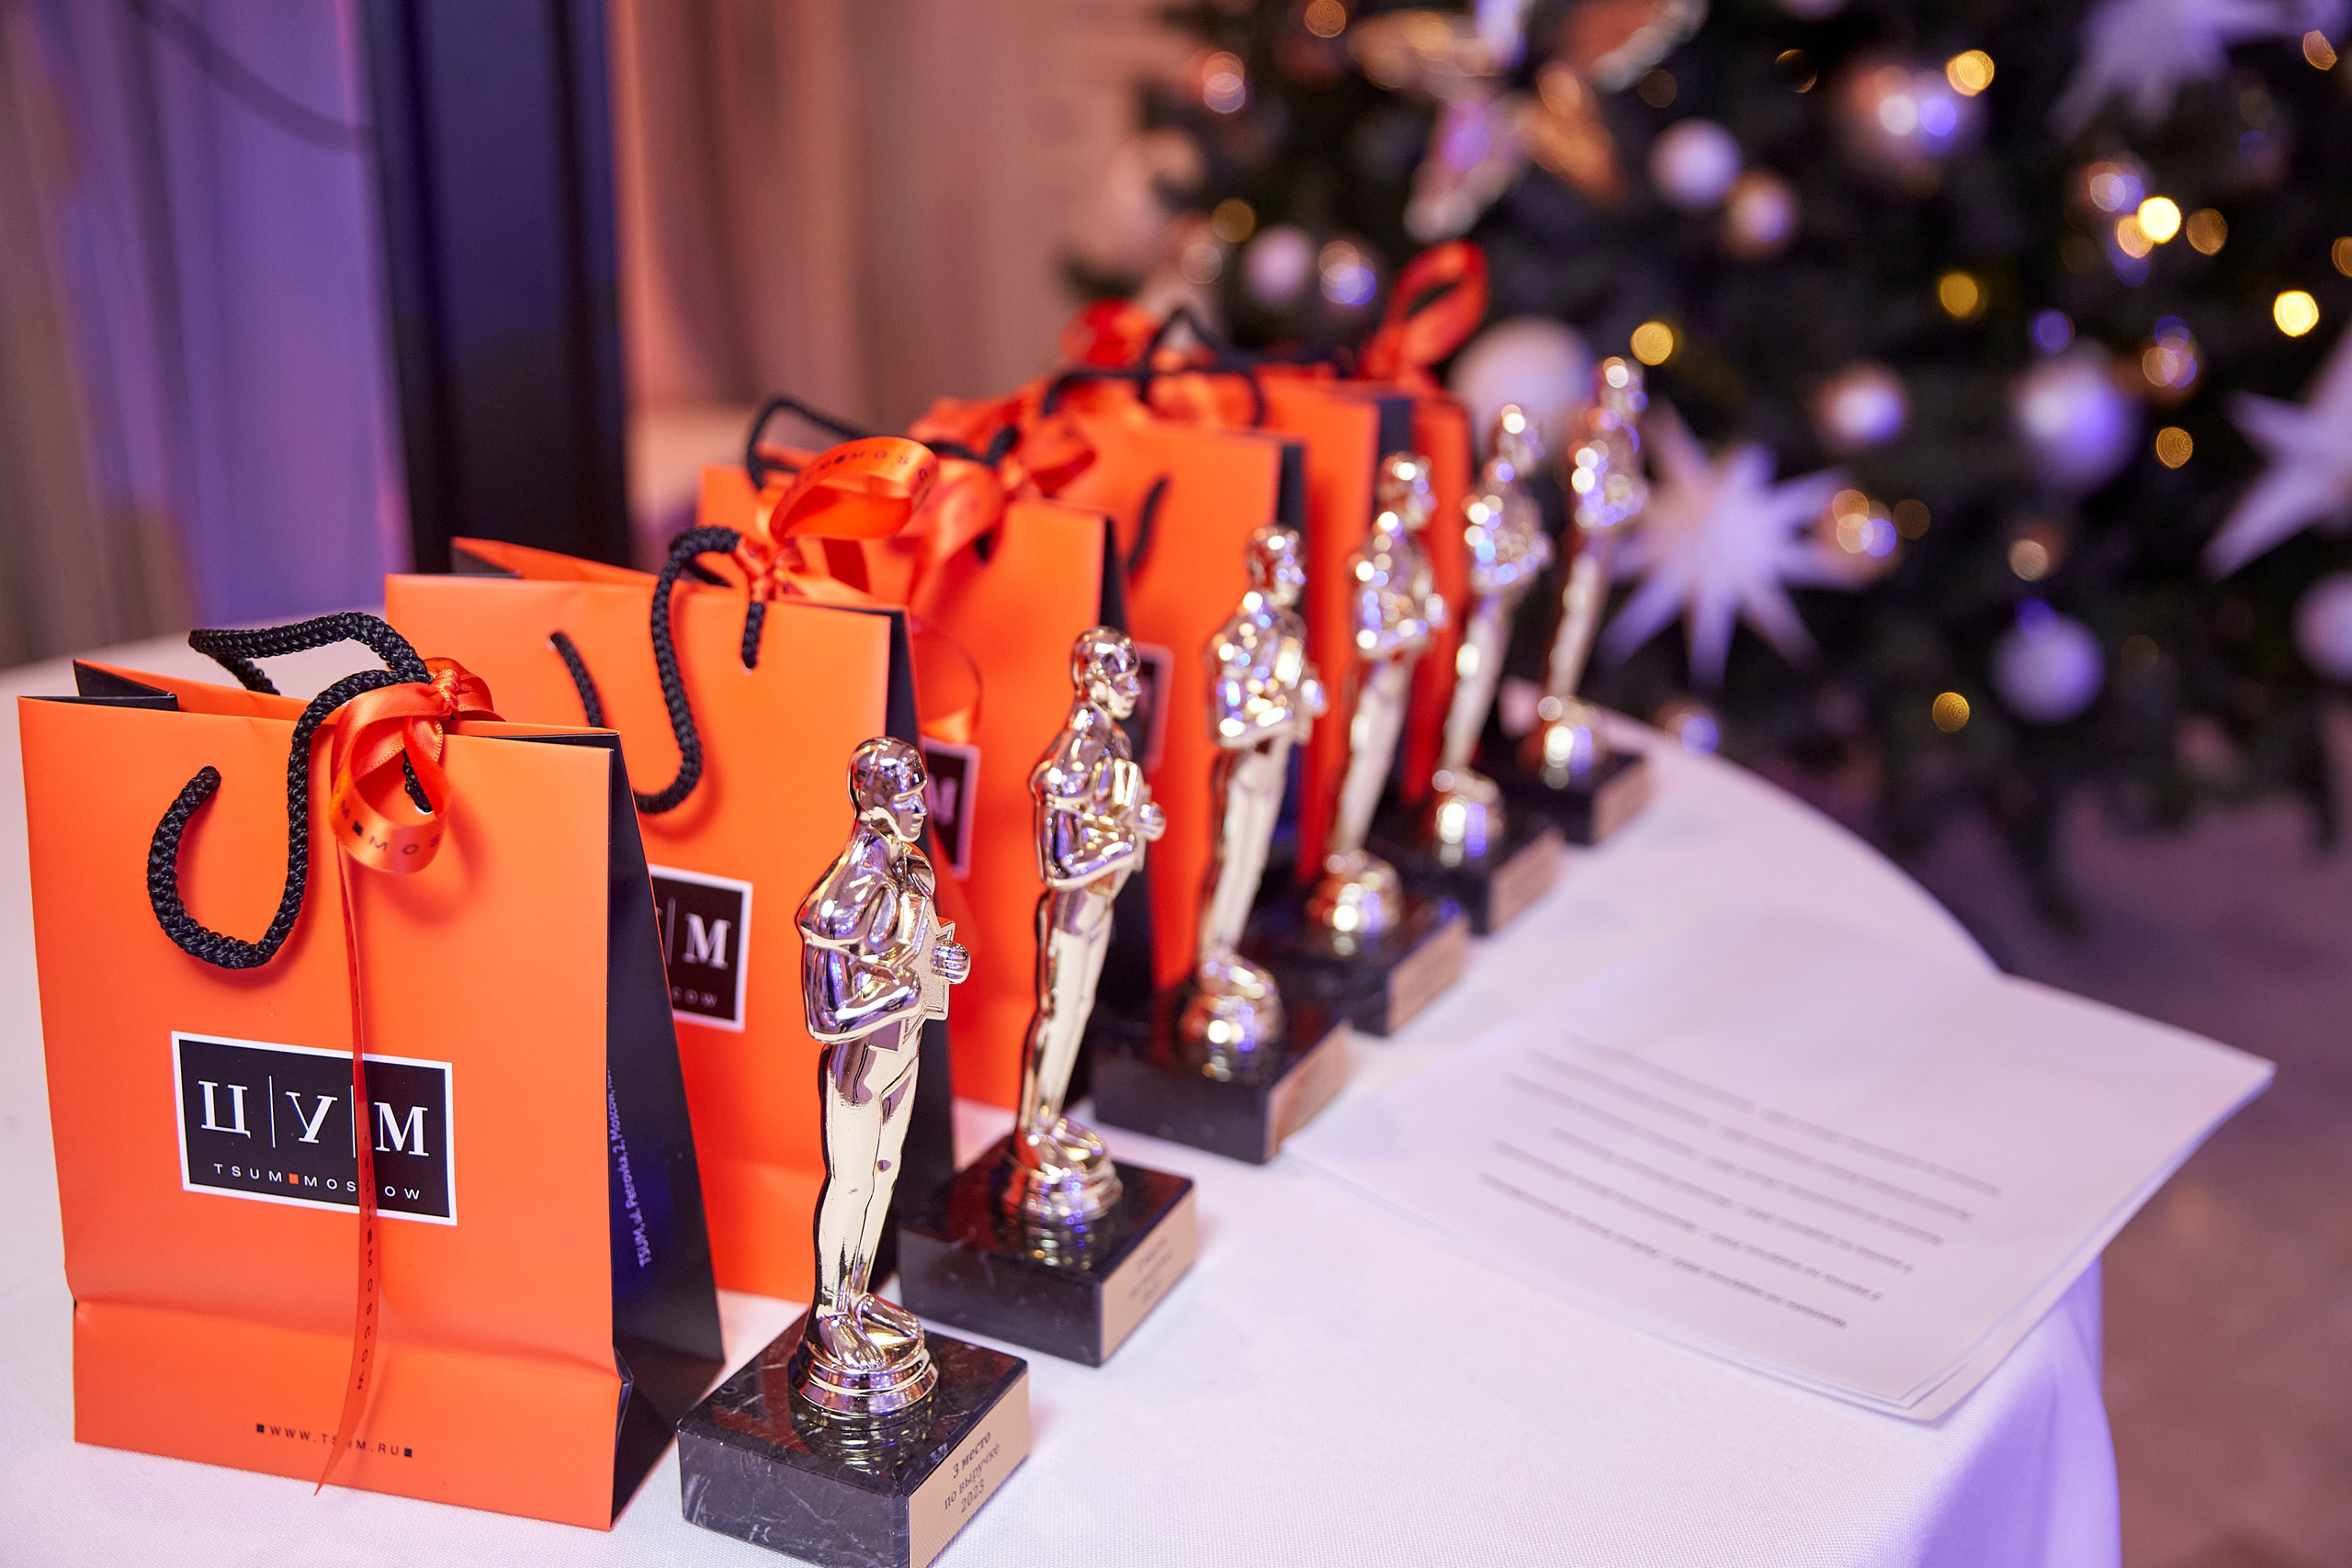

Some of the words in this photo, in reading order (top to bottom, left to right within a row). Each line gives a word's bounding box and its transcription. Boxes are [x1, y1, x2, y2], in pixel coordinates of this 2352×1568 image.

[213, 1162, 283, 1184] TSUM
[304, 1175, 421, 1201] MOSOW
[269, 1425, 399, 1456] WWW.TSM.RU
[952, 1462, 960, 1480] 3
[961, 1431, 991, 1470] место
[944, 1491, 957, 1511] по
[958, 1443, 1001, 1495] выручке
